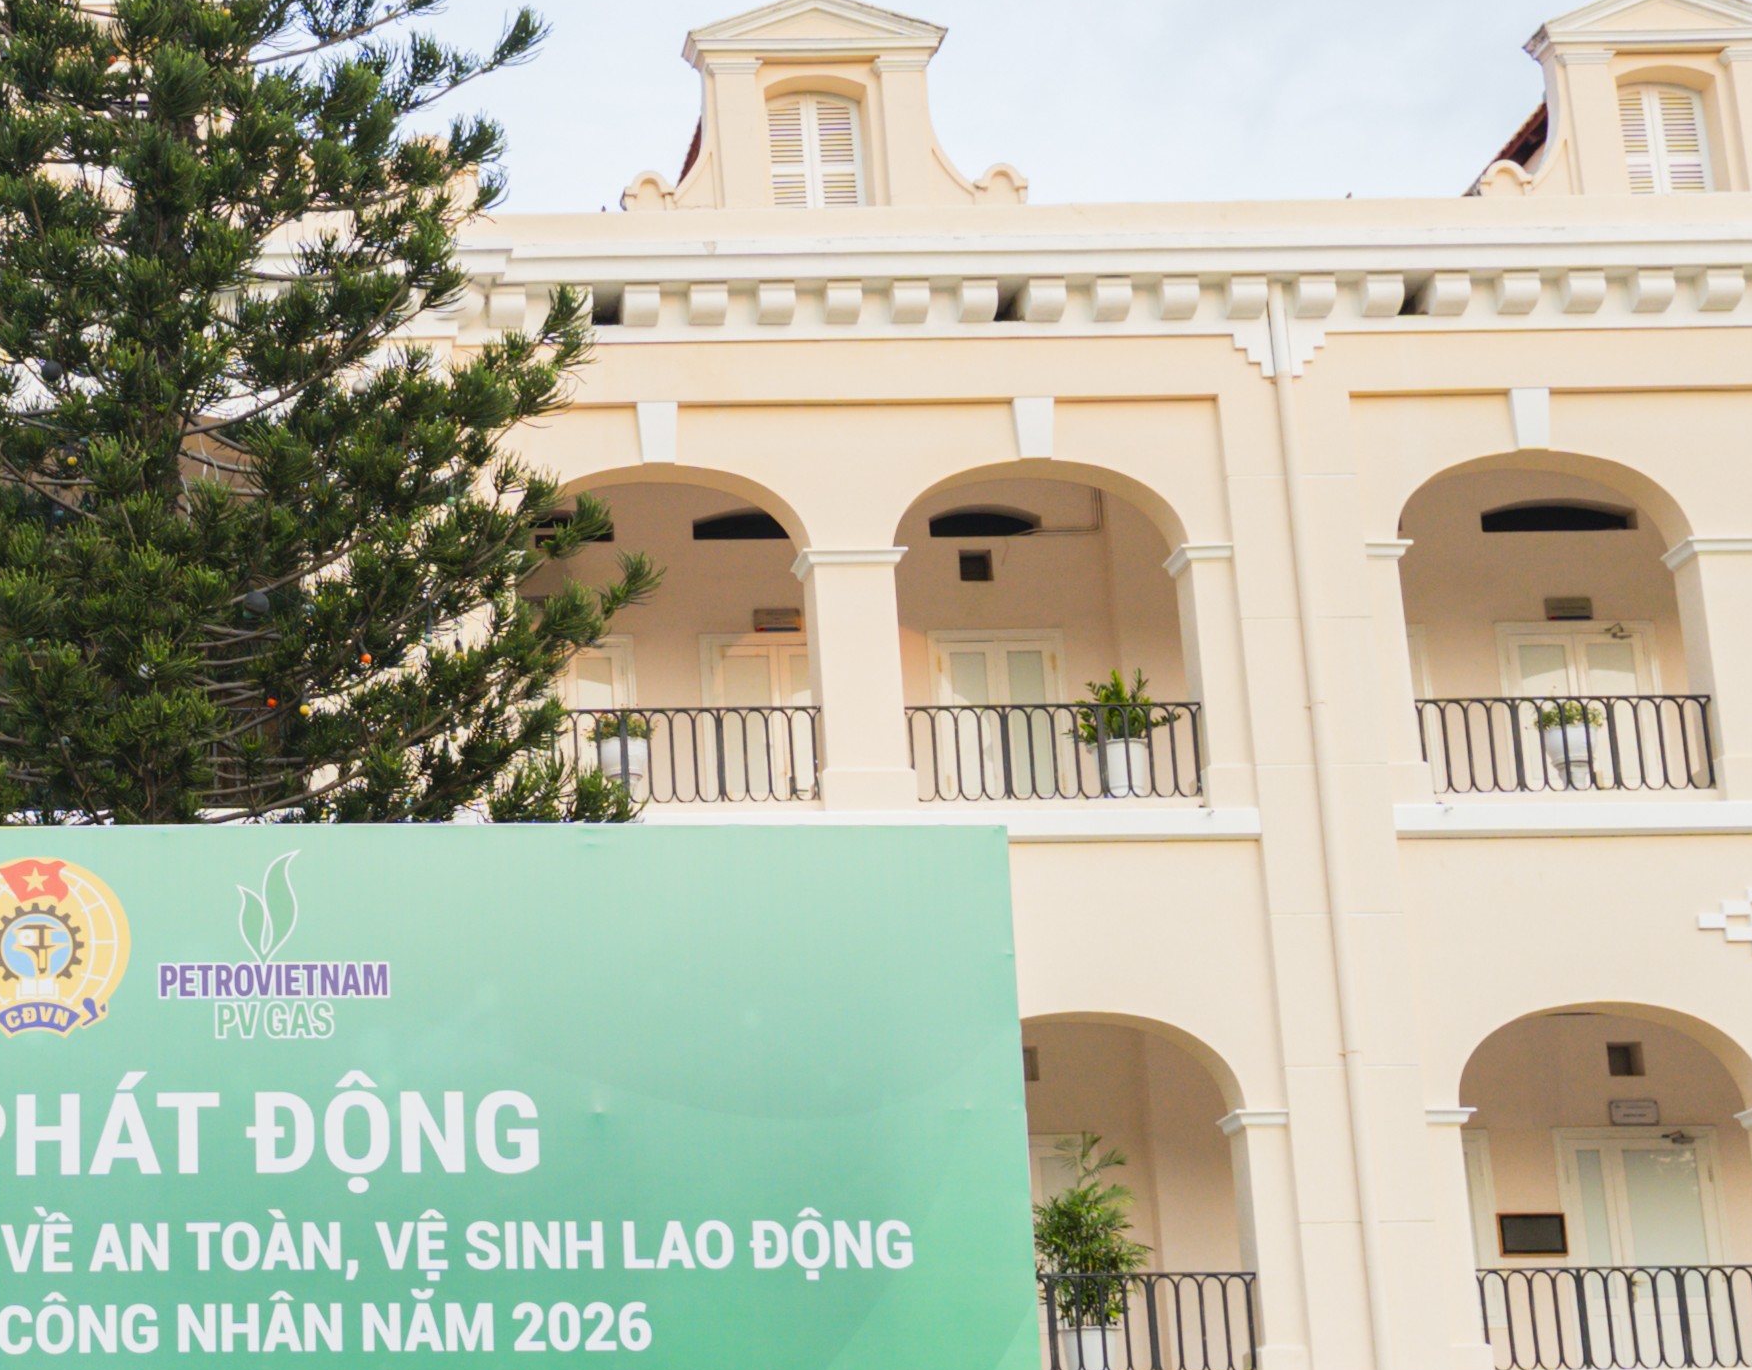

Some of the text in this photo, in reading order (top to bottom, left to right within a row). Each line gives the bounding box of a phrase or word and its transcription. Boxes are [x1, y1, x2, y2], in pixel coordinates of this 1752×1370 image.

[157, 961, 391, 999] PETROVIETNAM
[4, 1005, 69, 1029] CĐVN
[215, 1001, 336, 1039] PV GAS
[246, 1069, 541, 1194] ĐỘNG
[0, 1206, 73, 1275] VỀ
[89, 1222, 170, 1274] AN
[185, 1208, 359, 1283] TOÀN,
[374, 1208, 449, 1284] VỆ
[465, 1220, 605, 1271] SINH
[622, 1219, 735, 1271] LAO
[749, 1206, 916, 1282] ĐỘNG
[177, 1292, 343, 1354] NHÂN
[362, 1290, 494, 1353] NĂM
[512, 1301, 652, 1353] 2026
